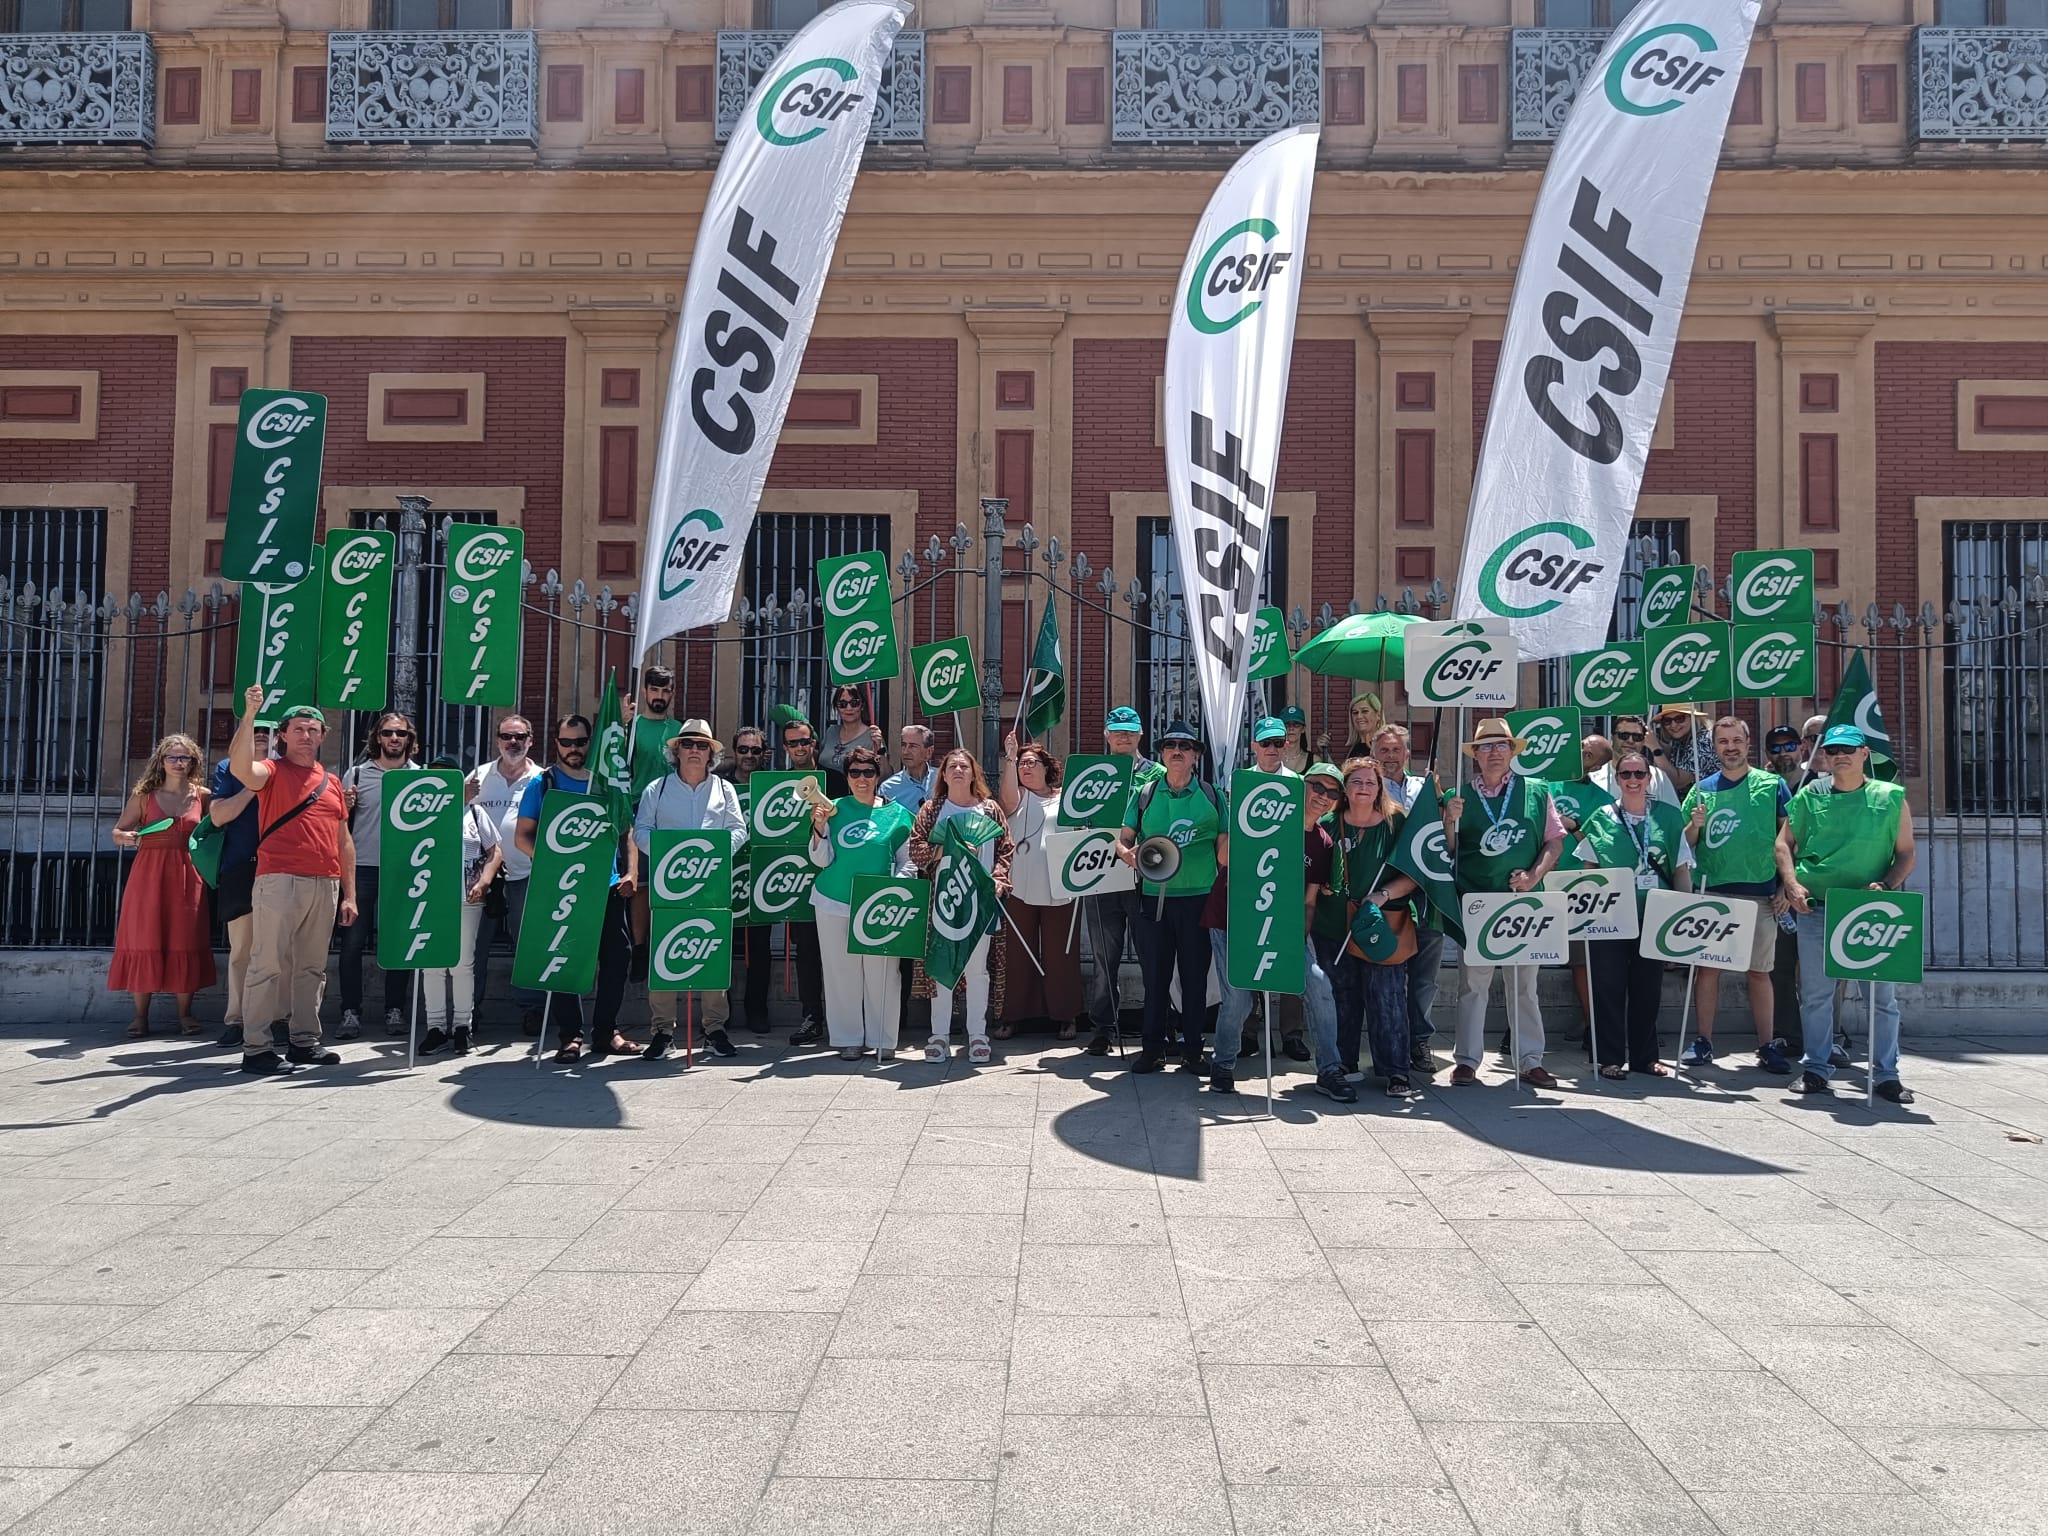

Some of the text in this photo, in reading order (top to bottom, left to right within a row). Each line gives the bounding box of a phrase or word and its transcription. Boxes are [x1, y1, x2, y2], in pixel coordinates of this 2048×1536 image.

[1630, 48, 1725, 95] CSIF
[780, 83, 864, 121] CSIF
[1207, 252, 1292, 297] CSIF
[691, 205, 800, 455] CSIF
[1524, 175, 1663, 464] CSIF
[260, 412, 316, 433] CSIF
[342, 550, 385, 569] CSIF
[467, 547, 515, 566] CSIF
[667, 537, 729, 572] CSIF
[1505, 548, 1604, 594] CSIF
[836, 574, 879, 598] CSIF
[1750, 575, 1804, 597] CSIF
[1650, 590, 1685, 610] CSIF
[843, 635, 887, 658] CSIF
[1250, 632, 1278, 655] SIF
[1663, 650, 1720, 675] CSIF
[1750, 649, 1804, 670] CSIF
[929, 663, 966, 688] CSIF
[1587, 667, 1639, 689] CSIF
[1475, 693, 1506, 701] SEVILLA
[1522, 733, 1571, 756] CSIF
[1075, 779, 1123, 800] CSIF
[403, 792, 454, 813] CSIF
[480, 800, 519, 808] POLO LEA
[1250, 798, 1296, 822] CSIF
[559, 816, 611, 839] CSIF
[846, 826, 880, 840] CSIF
[1710, 815, 1741, 835] CSIF
[667, 857, 723, 881] CSIF
[732, 880, 750, 899] CS
[766, 873, 815, 893] CSIF
[938, 855, 973, 920] CSIF
[866, 903, 920, 927] CSIF
[1587, 926, 1618, 934] SEVILLA
[1847, 922, 1912, 948] CSIF
[668, 938, 723, 961] CSIF
[1700, 952, 1732, 963] SEVILLA
